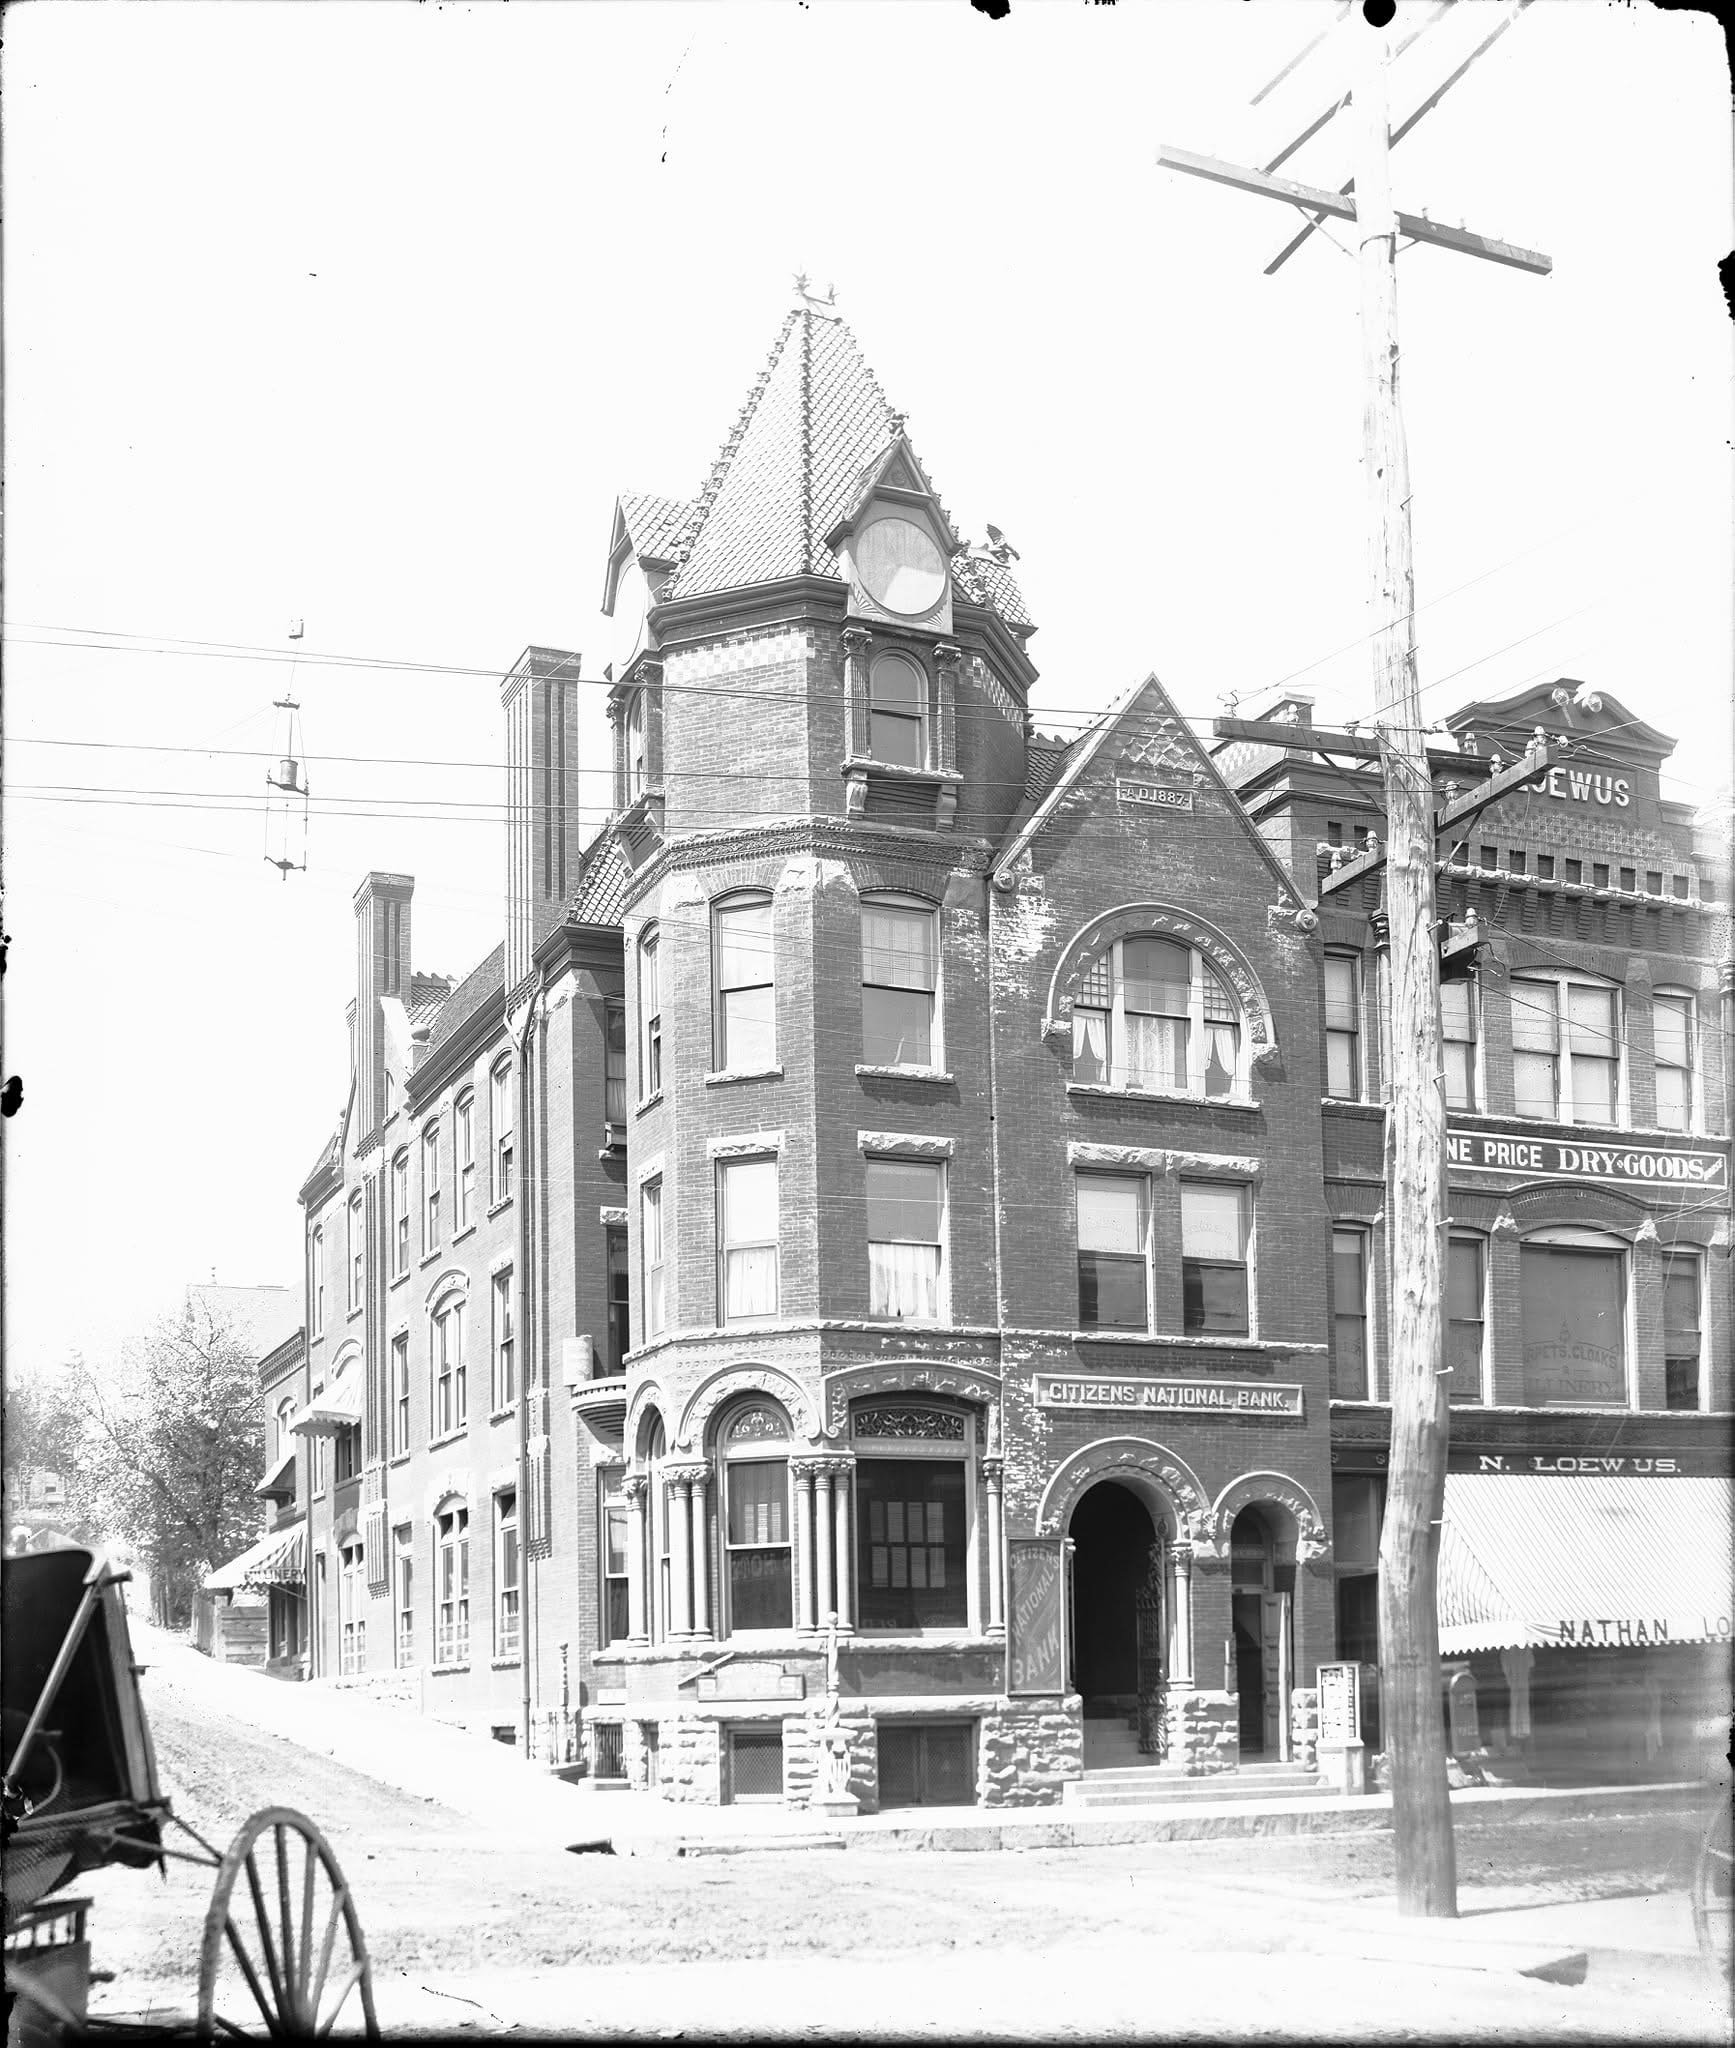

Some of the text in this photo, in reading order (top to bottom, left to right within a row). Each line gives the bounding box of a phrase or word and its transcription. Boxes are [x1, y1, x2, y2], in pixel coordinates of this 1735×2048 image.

[1516, 766, 1630, 807] OEWUS
[1446, 1137, 1473, 1162] NE
[1484, 1141, 1544, 1168] PRICE
[1558, 1147, 1620, 1174] DRY
[1623, 1153, 1704, 1180] GOODS
[1049, 1382, 1135, 1402] CITIZENS
[1143, 1386, 1232, 1407] NATIONAL
[1479, 1455, 1510, 1471] N.
[1010, 1547, 1060, 1569] CITIZENS
[1011, 1565, 1055, 1646] NATIONAL
[1559, 1618, 1669, 1643] NATHAN
[1012, 1623, 1060, 1686] BANK
